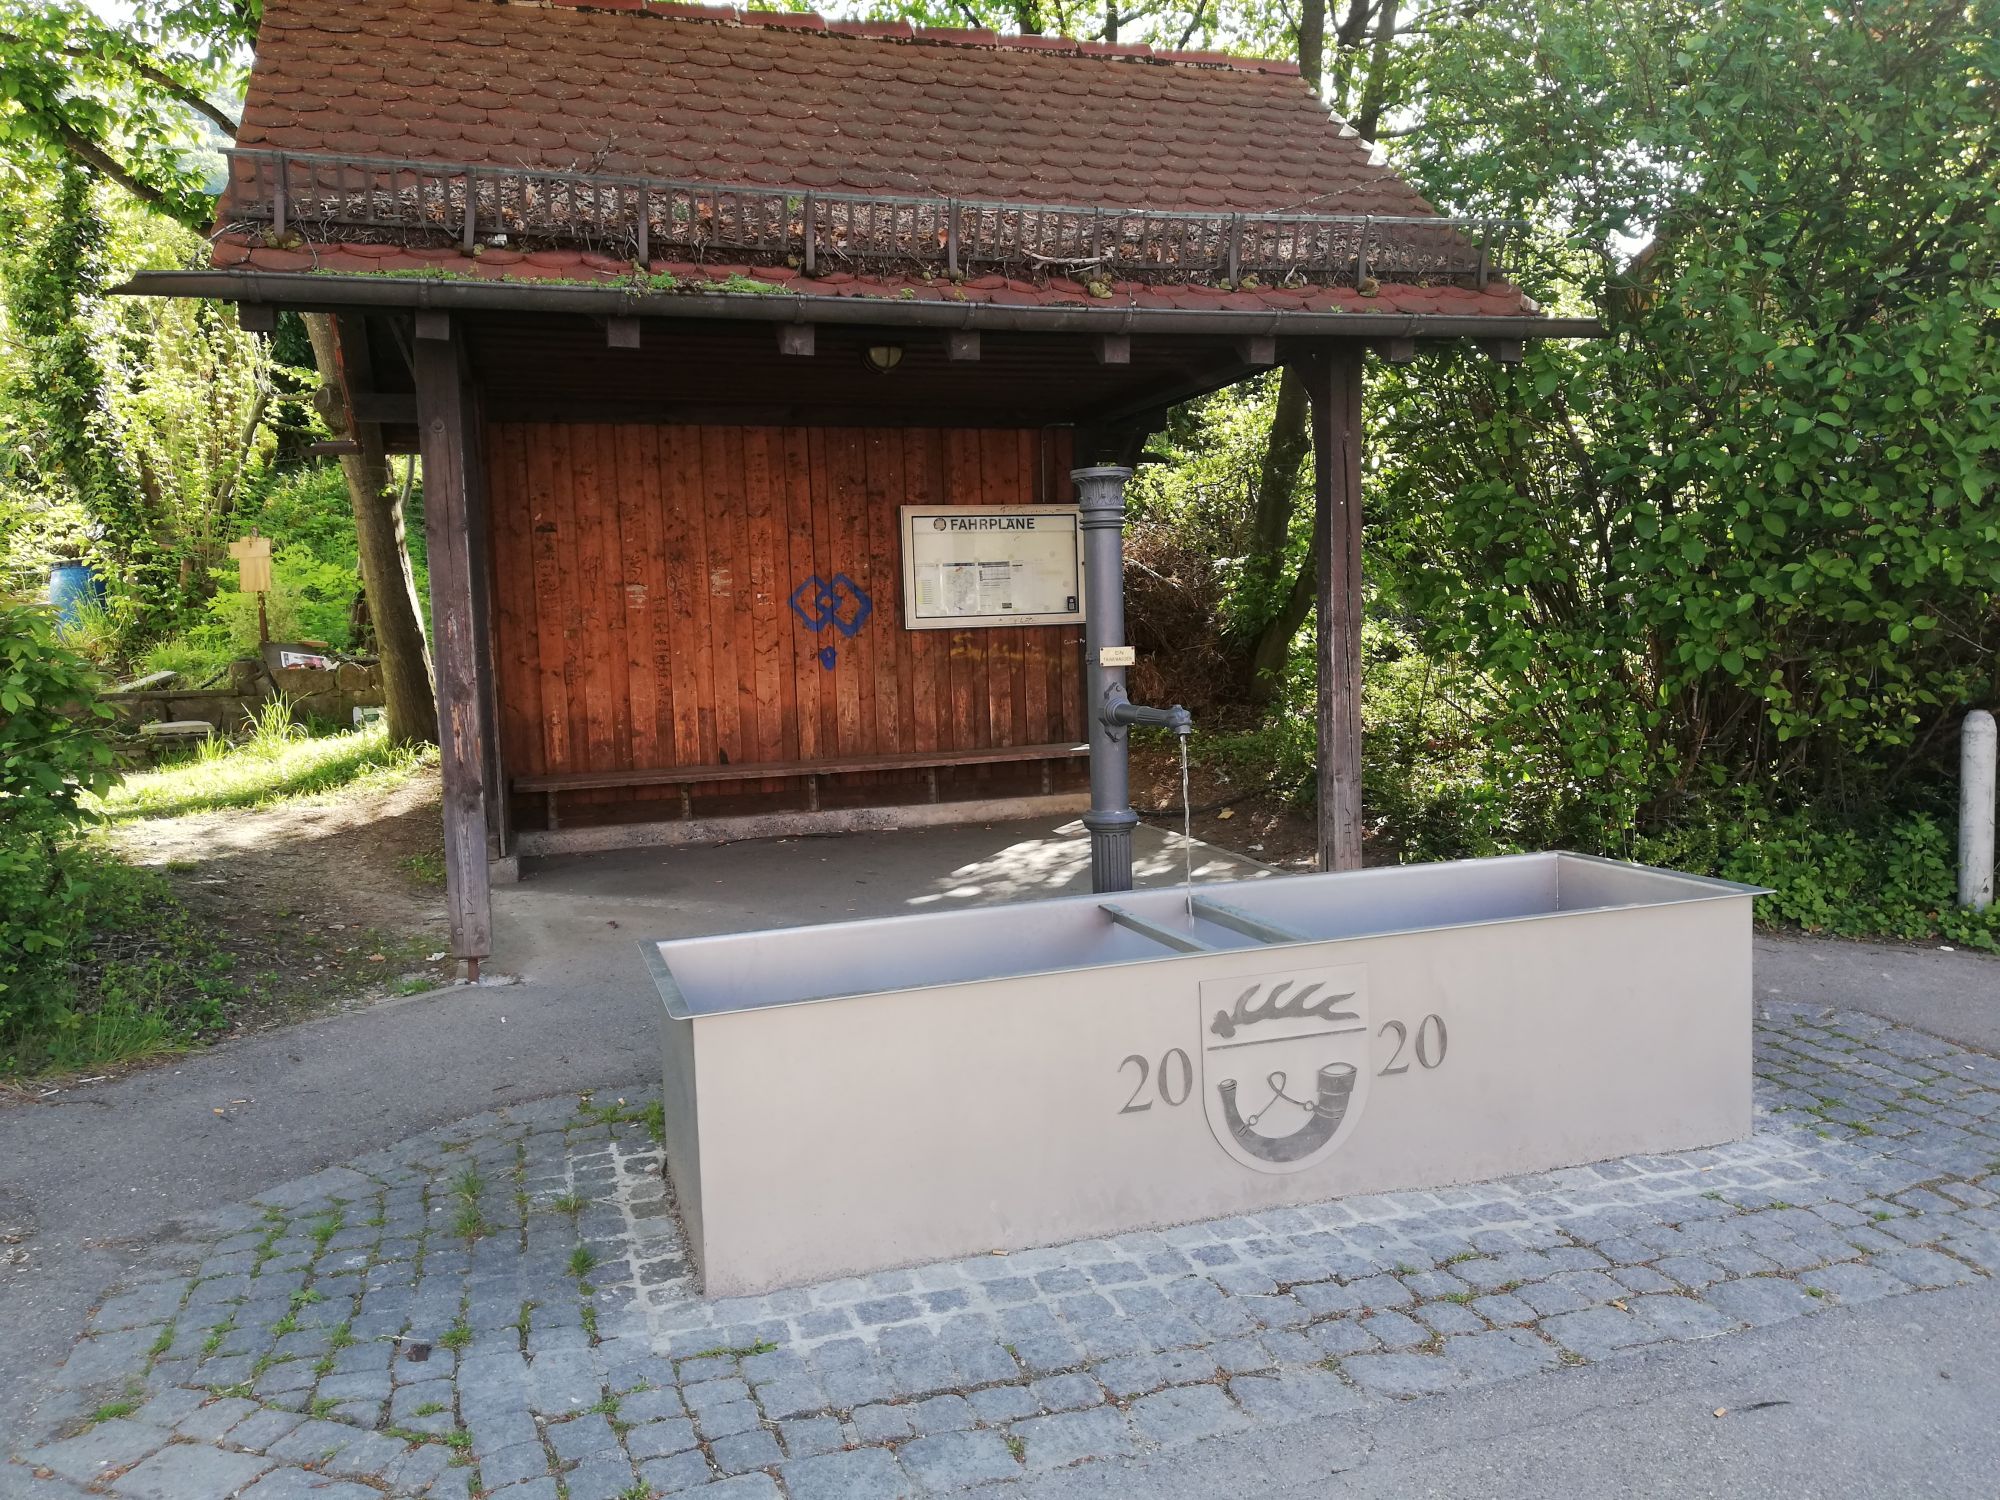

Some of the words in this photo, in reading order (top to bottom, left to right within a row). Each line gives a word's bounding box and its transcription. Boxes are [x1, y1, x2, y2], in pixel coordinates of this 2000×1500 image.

[950, 518, 1035, 531] FAHRPLÄNE
[1117, 1047, 1193, 1115] 20
[1377, 1013, 1448, 1077] 20
